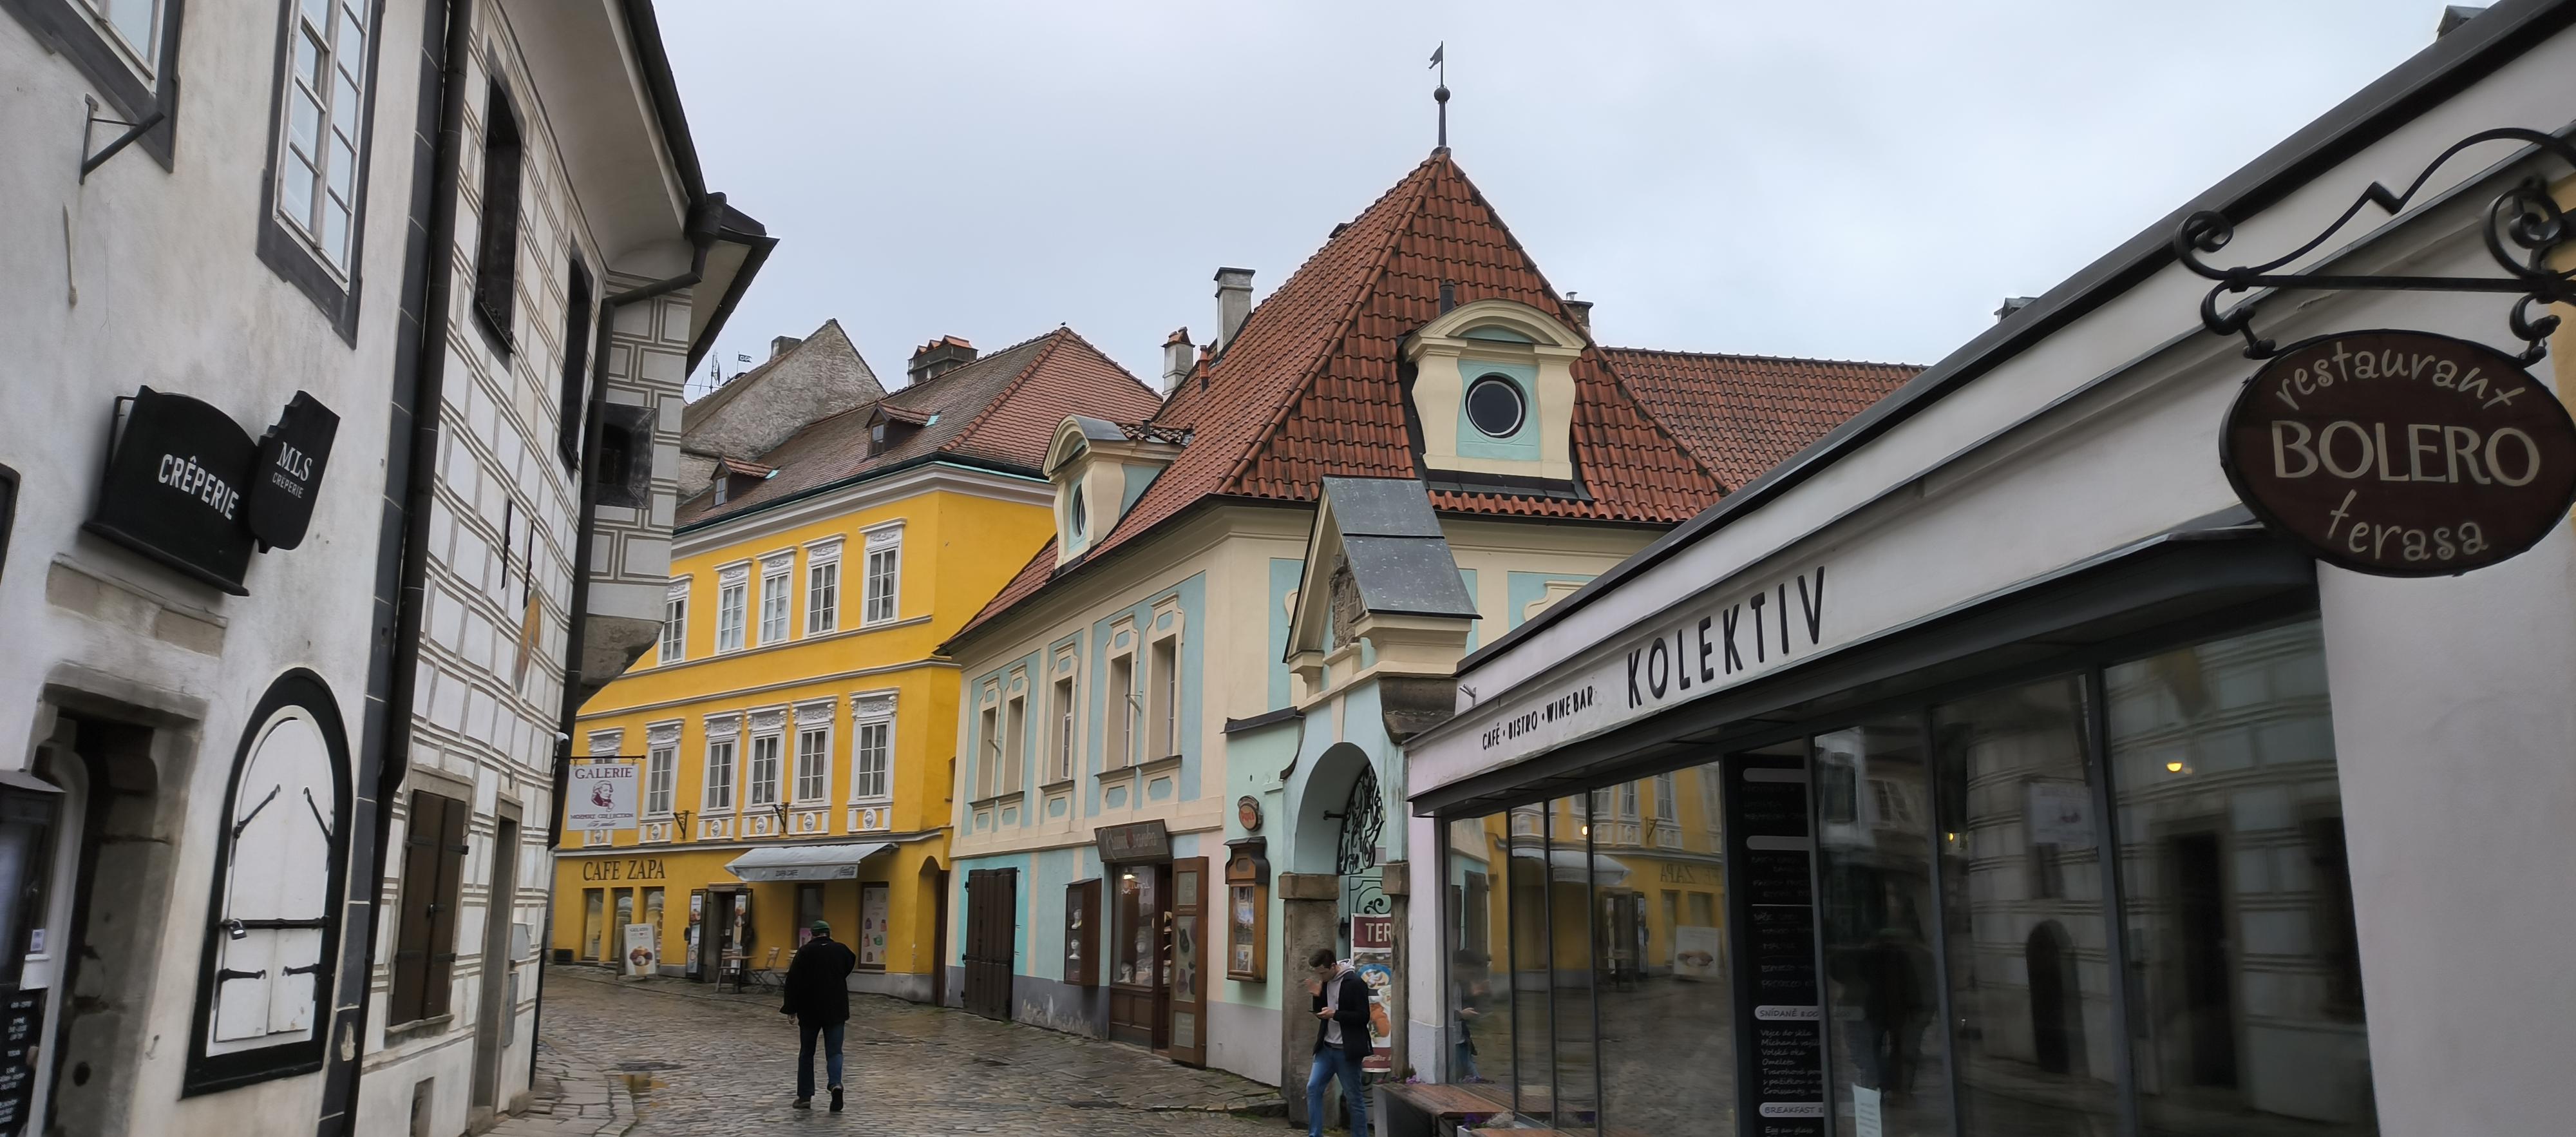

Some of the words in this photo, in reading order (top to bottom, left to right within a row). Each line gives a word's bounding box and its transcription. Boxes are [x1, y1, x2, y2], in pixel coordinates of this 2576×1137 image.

[2275, 341, 2525, 410] restaurant
[271, 471, 304, 500] CRÊPERIE
[276, 441, 314, 482] MLS
[2271, 420, 2541, 487] BOLERO
[158, 454, 240, 521] CRÊPERIE
[2327, 489, 2489, 561] terasa
[1627, 566, 1825, 709] KOLEKTIV
[1482, 721, 1500, 750] CAFÉ
[1508, 711, 1538, 740] BISTRO
[1546, 695, 1571, 723] WINE
[1573, 685, 1593, 712] BAR
[574, 767, 634, 779] GALERIE
[583, 860, 621, 881] CAFE
[627, 858, 666, 880] ZAPA
[1759, 1008, 1797, 1017] SNÍDANĚ
